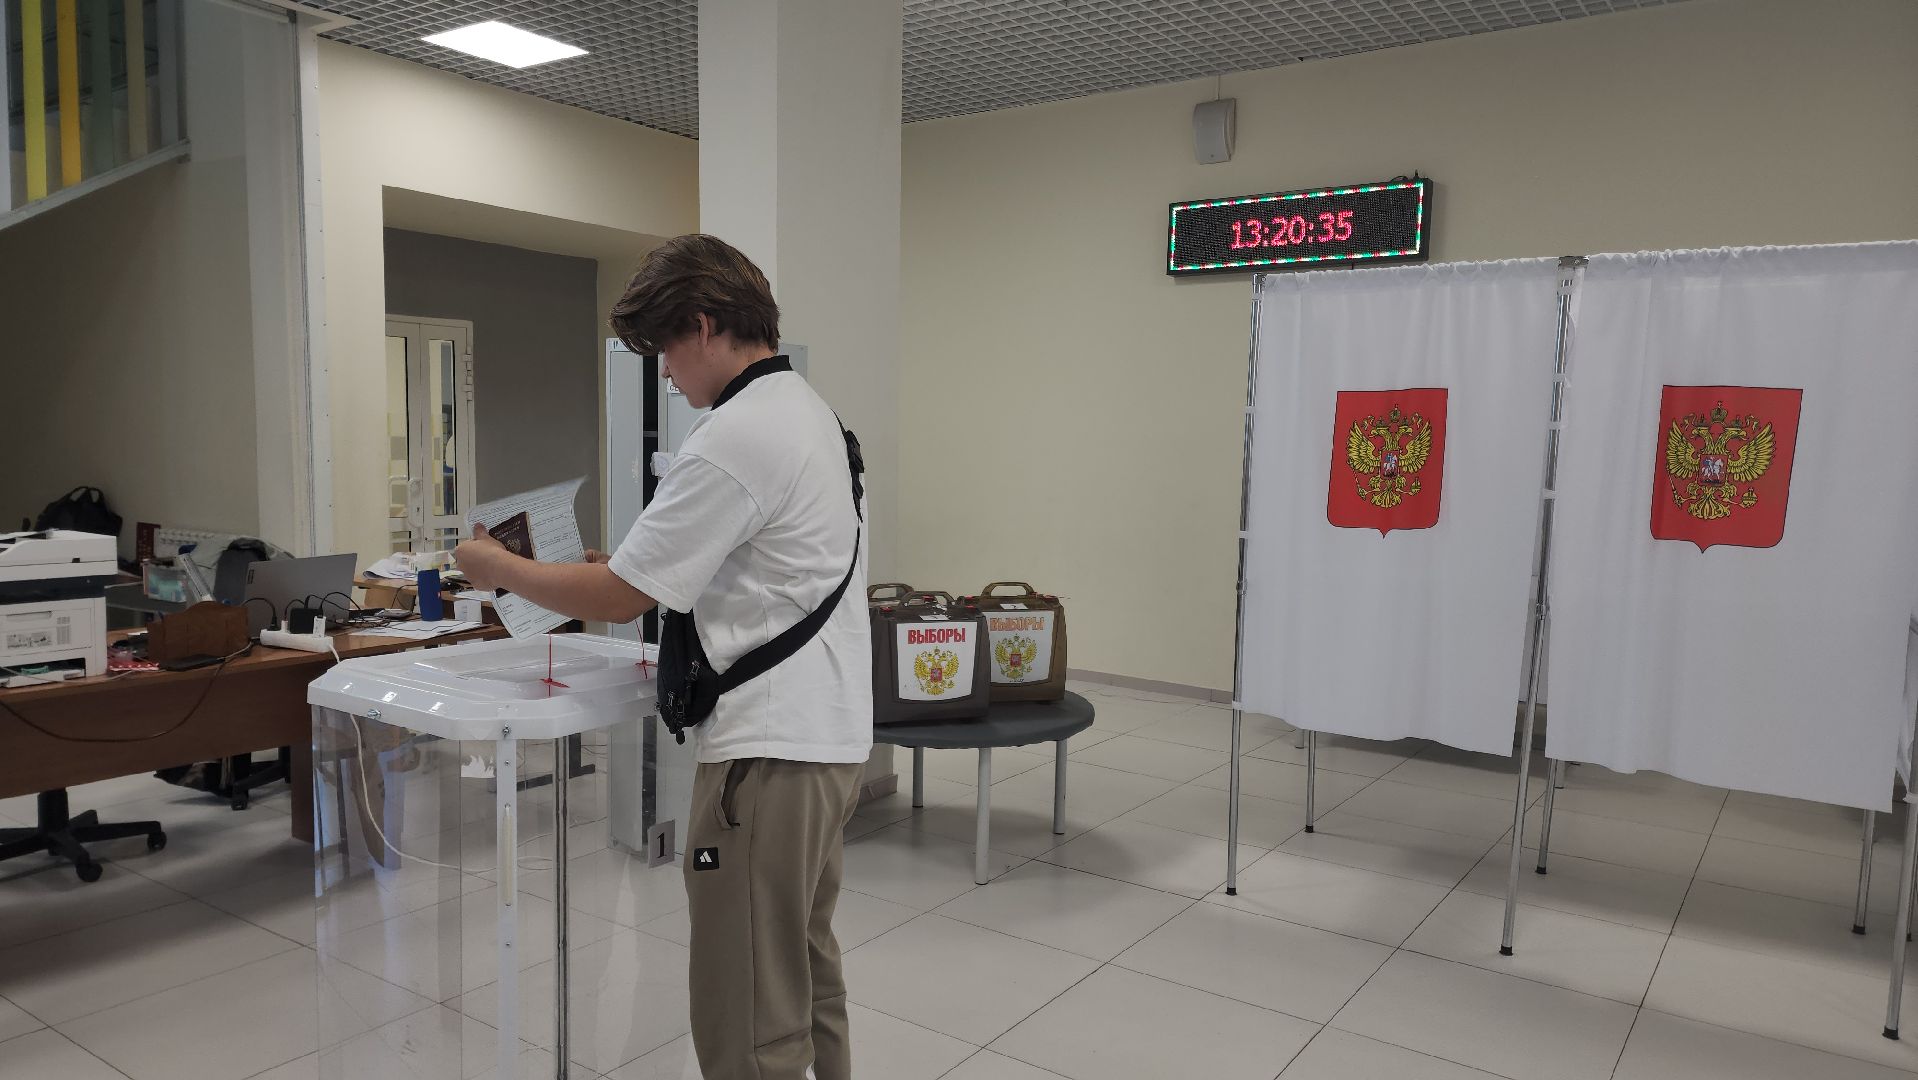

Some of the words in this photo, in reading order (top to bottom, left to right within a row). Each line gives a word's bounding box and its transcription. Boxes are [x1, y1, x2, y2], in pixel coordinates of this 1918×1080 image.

[1230, 211, 1353, 249] 13:20:35
[989, 617, 1044, 631] ВЫБОРЫ
[908, 628, 966, 644] ВЫБОРЫ
[656, 831, 667, 859] 1
